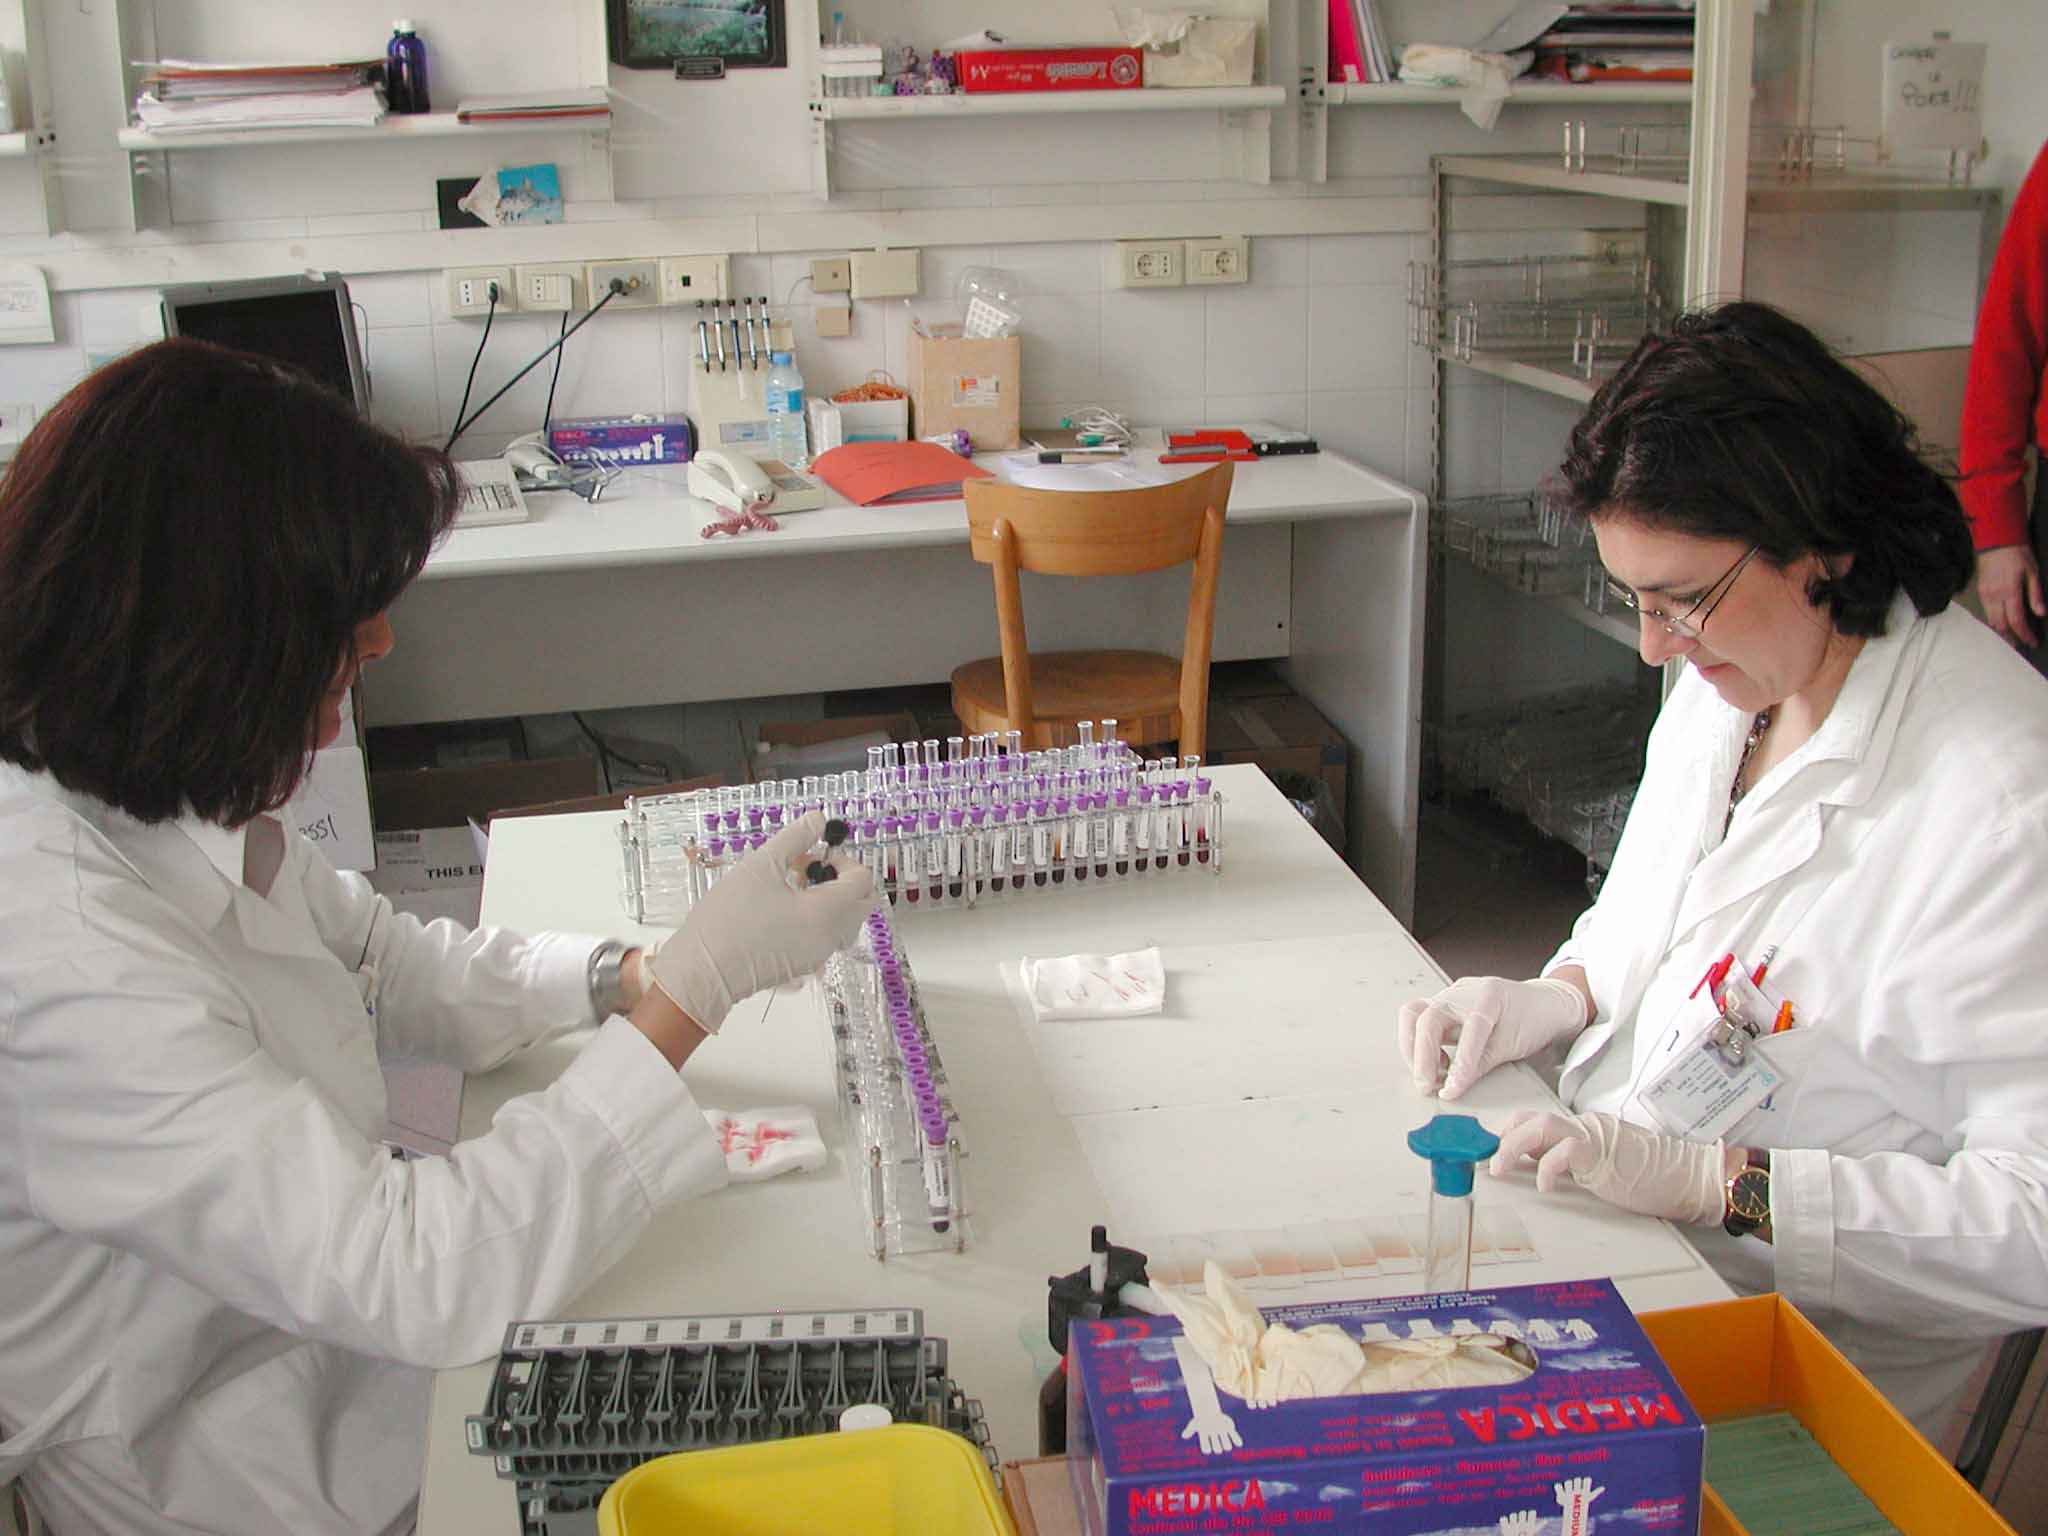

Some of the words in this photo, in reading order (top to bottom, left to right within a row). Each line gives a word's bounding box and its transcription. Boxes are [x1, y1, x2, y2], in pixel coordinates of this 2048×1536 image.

[426, 867, 464, 879] THIS
[1457, 1393, 1683, 1442] MEDICA
[1128, 1479, 1265, 1521] MEDICA
